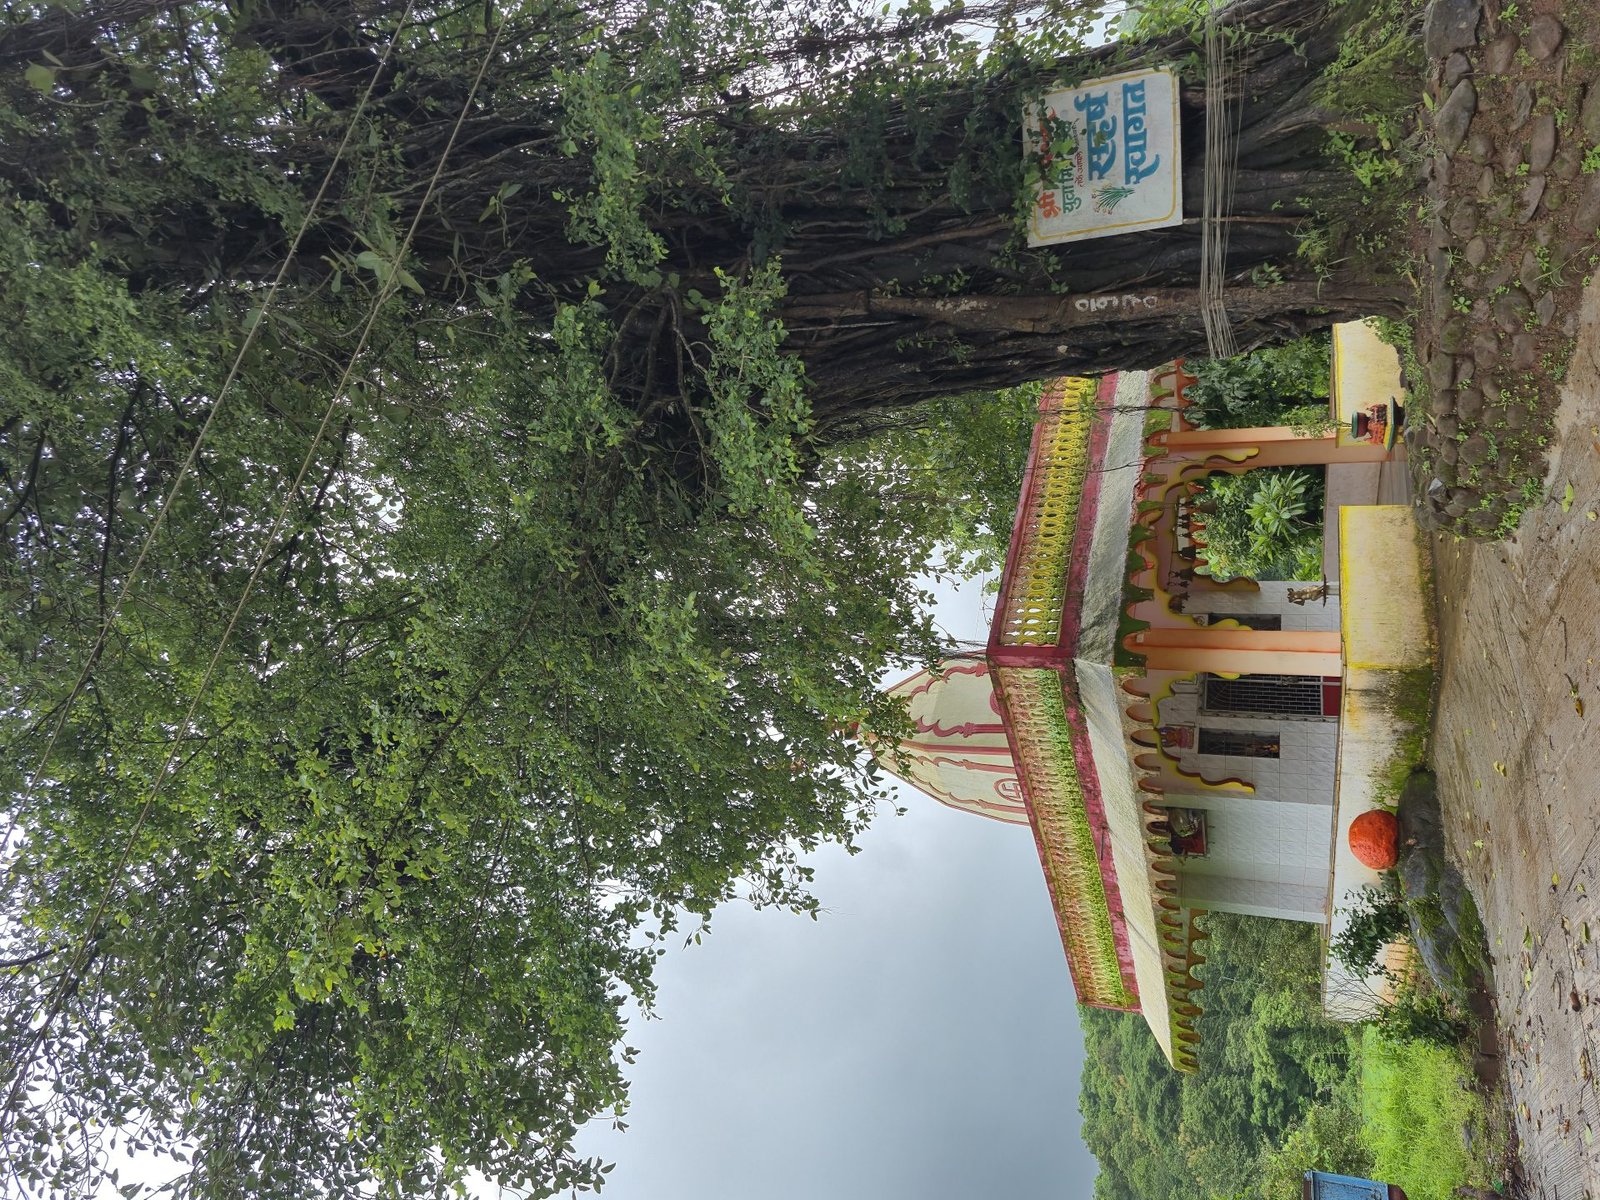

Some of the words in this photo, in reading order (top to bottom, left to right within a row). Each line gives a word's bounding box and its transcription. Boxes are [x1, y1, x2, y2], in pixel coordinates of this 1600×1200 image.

[1074, 91, 1117, 181] सहर्ष
[1122, 80, 1160, 185] स्वागत
[1038, 192, 1061, 219] श्री
[1062, 185, 1082, 213] युवा
